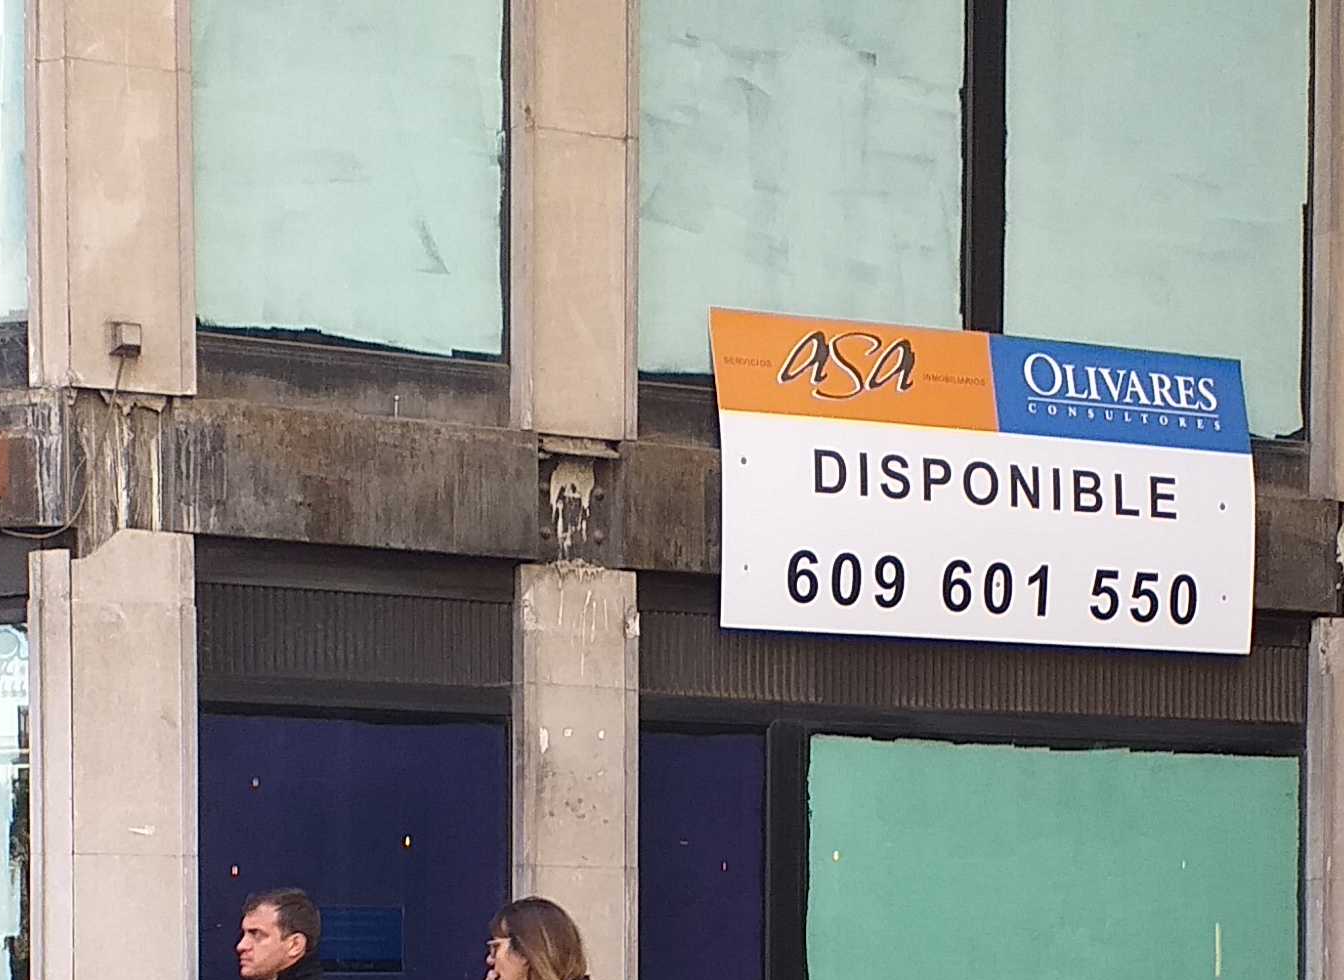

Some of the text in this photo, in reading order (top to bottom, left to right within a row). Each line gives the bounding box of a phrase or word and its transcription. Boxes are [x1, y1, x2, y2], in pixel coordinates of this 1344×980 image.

[1023, 352, 1219, 412] OLIVARES
[1028, 402, 1223, 432] CONSULTORES
[813, 448, 1178, 520] DISPONIBLE
[787, 549, 1197, 625] 609 601 550
